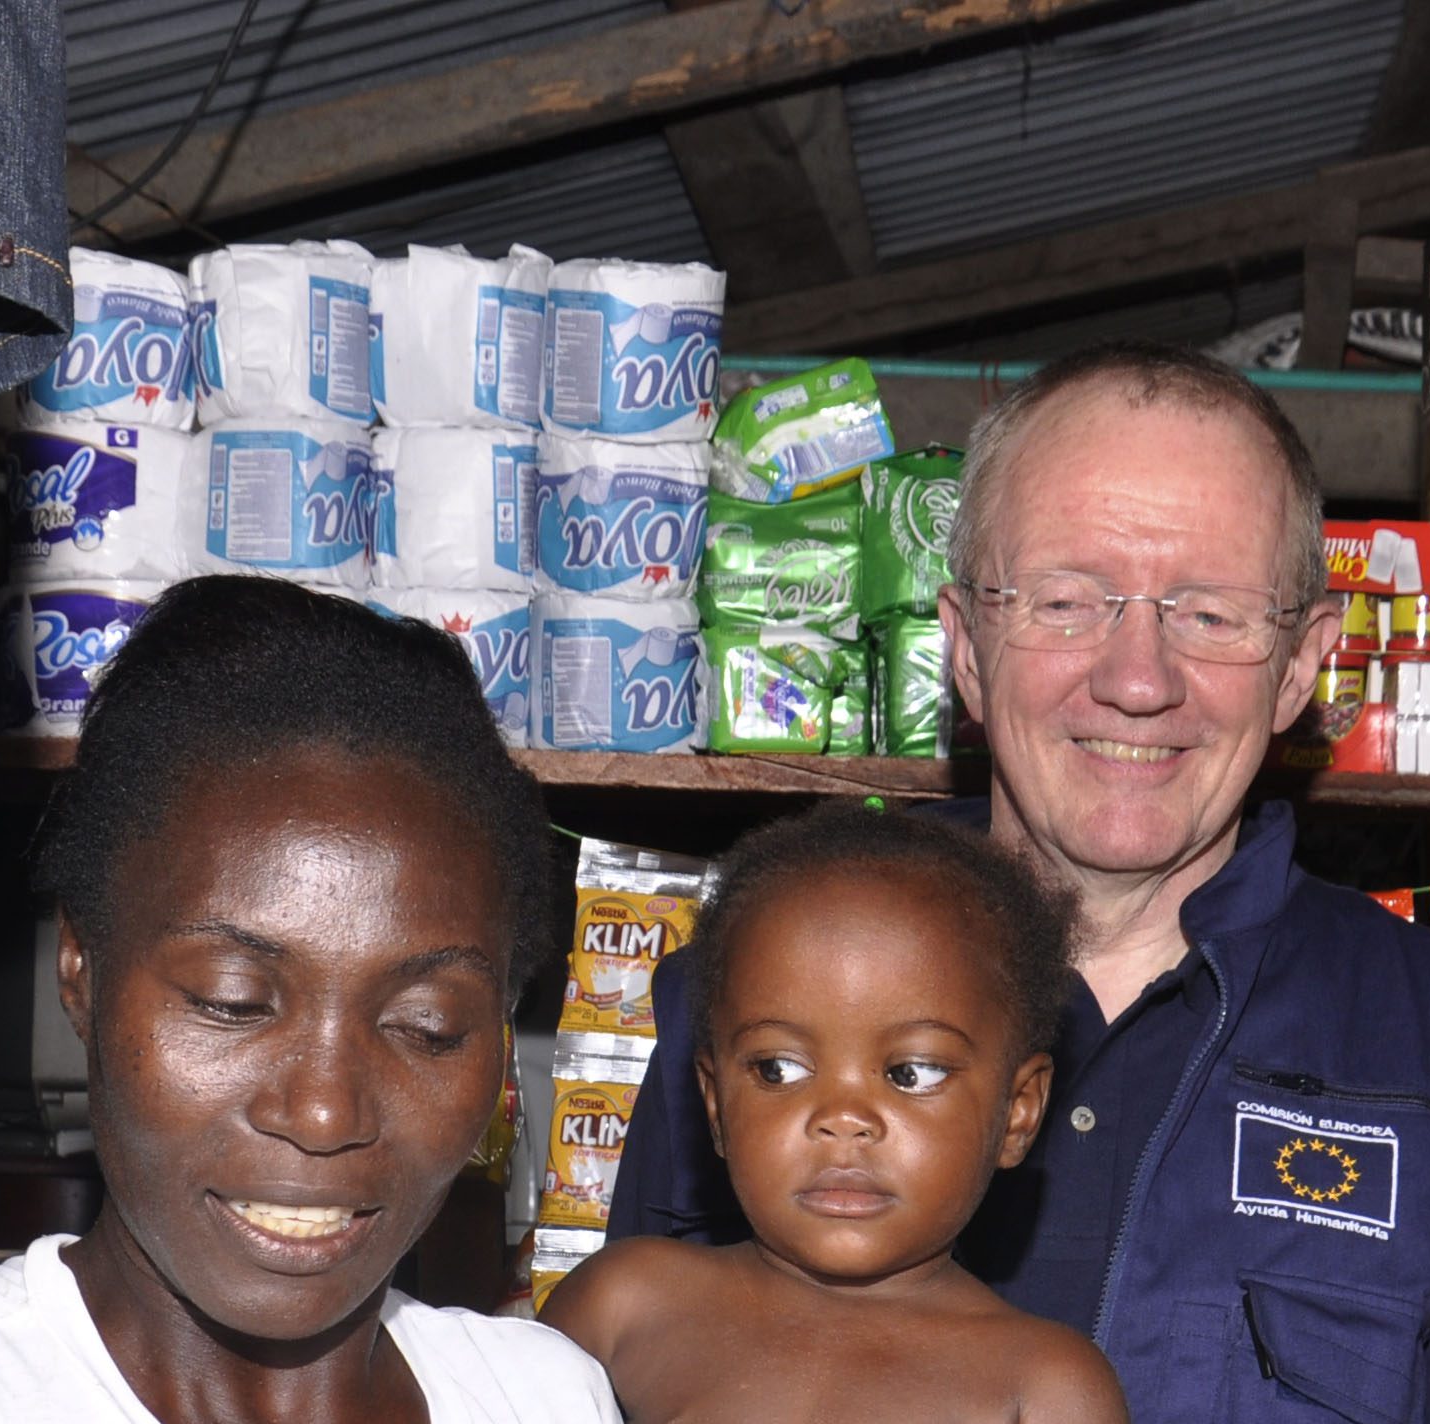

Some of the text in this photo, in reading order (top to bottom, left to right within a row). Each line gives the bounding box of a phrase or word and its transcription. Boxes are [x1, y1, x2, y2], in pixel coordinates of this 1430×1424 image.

[114, 430, 130, 446] G
[614, 474, 661, 493] Blanco
[561, 495, 708, 582] Joya
[583, 921, 665, 960] KLIM
[1319, 1118, 1397, 1138] EUROPEA
[1233, 1201, 1390, 1241] Ayuda Humanitaria
